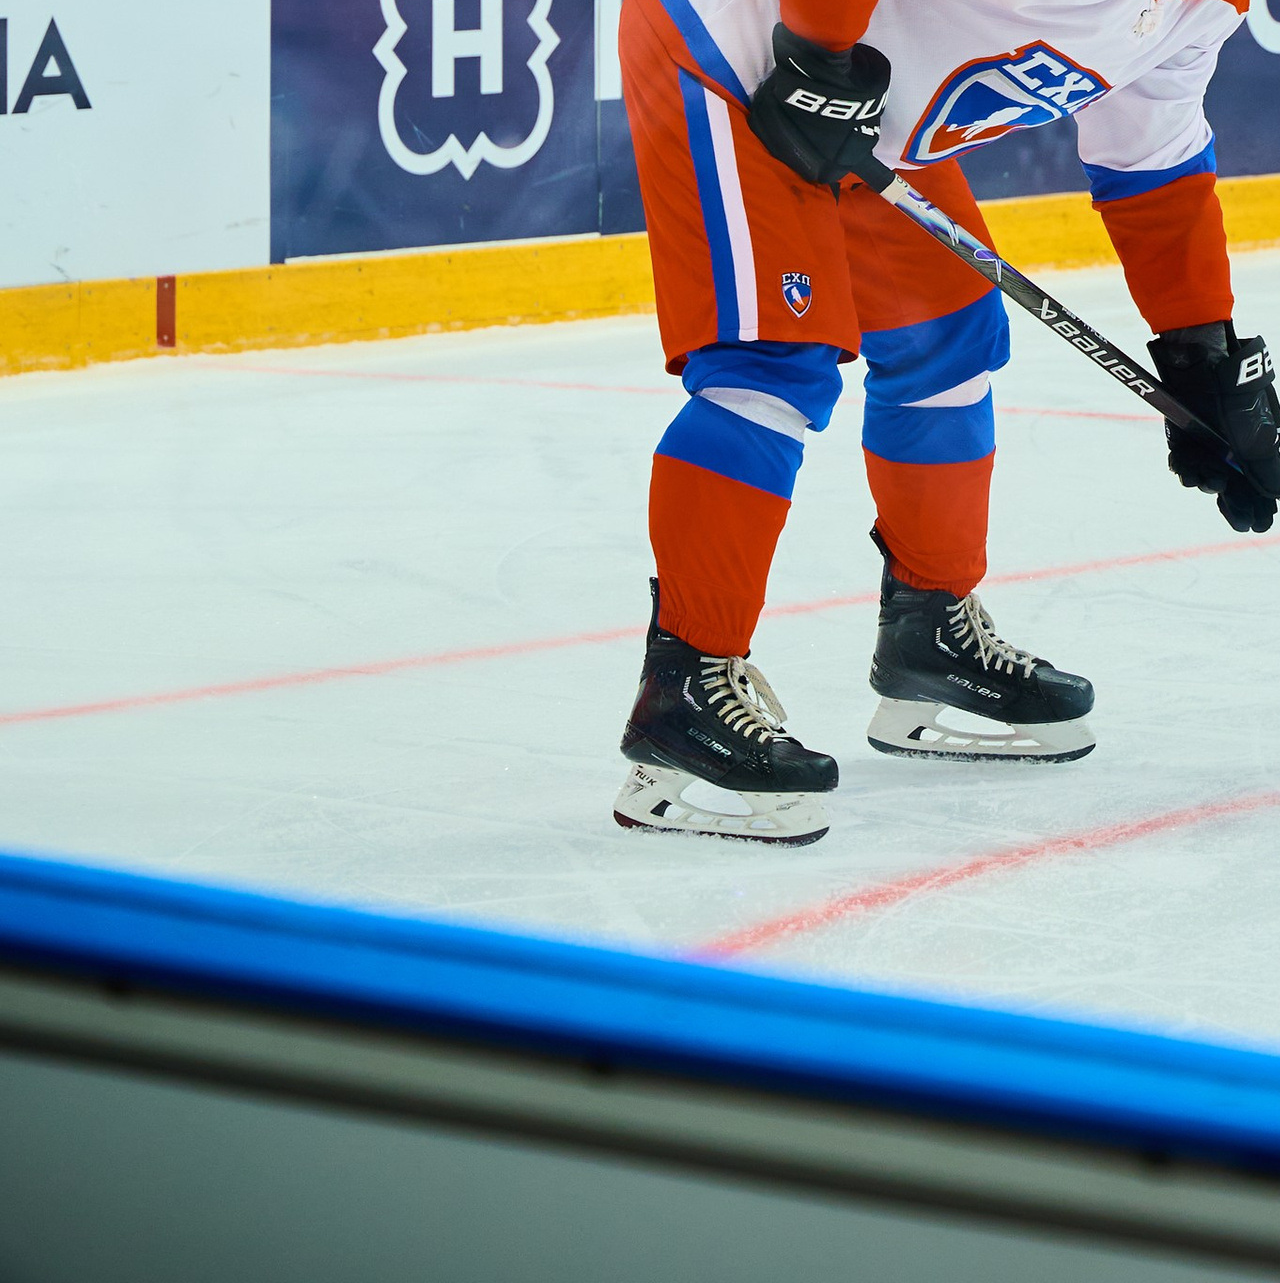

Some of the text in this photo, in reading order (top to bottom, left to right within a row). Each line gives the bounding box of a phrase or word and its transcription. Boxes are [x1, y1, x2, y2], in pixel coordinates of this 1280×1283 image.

[782, 272, 811, 286] СХП
[1051, 319, 1156, 397] BAUER
[686, 727, 732, 758] BAUER
